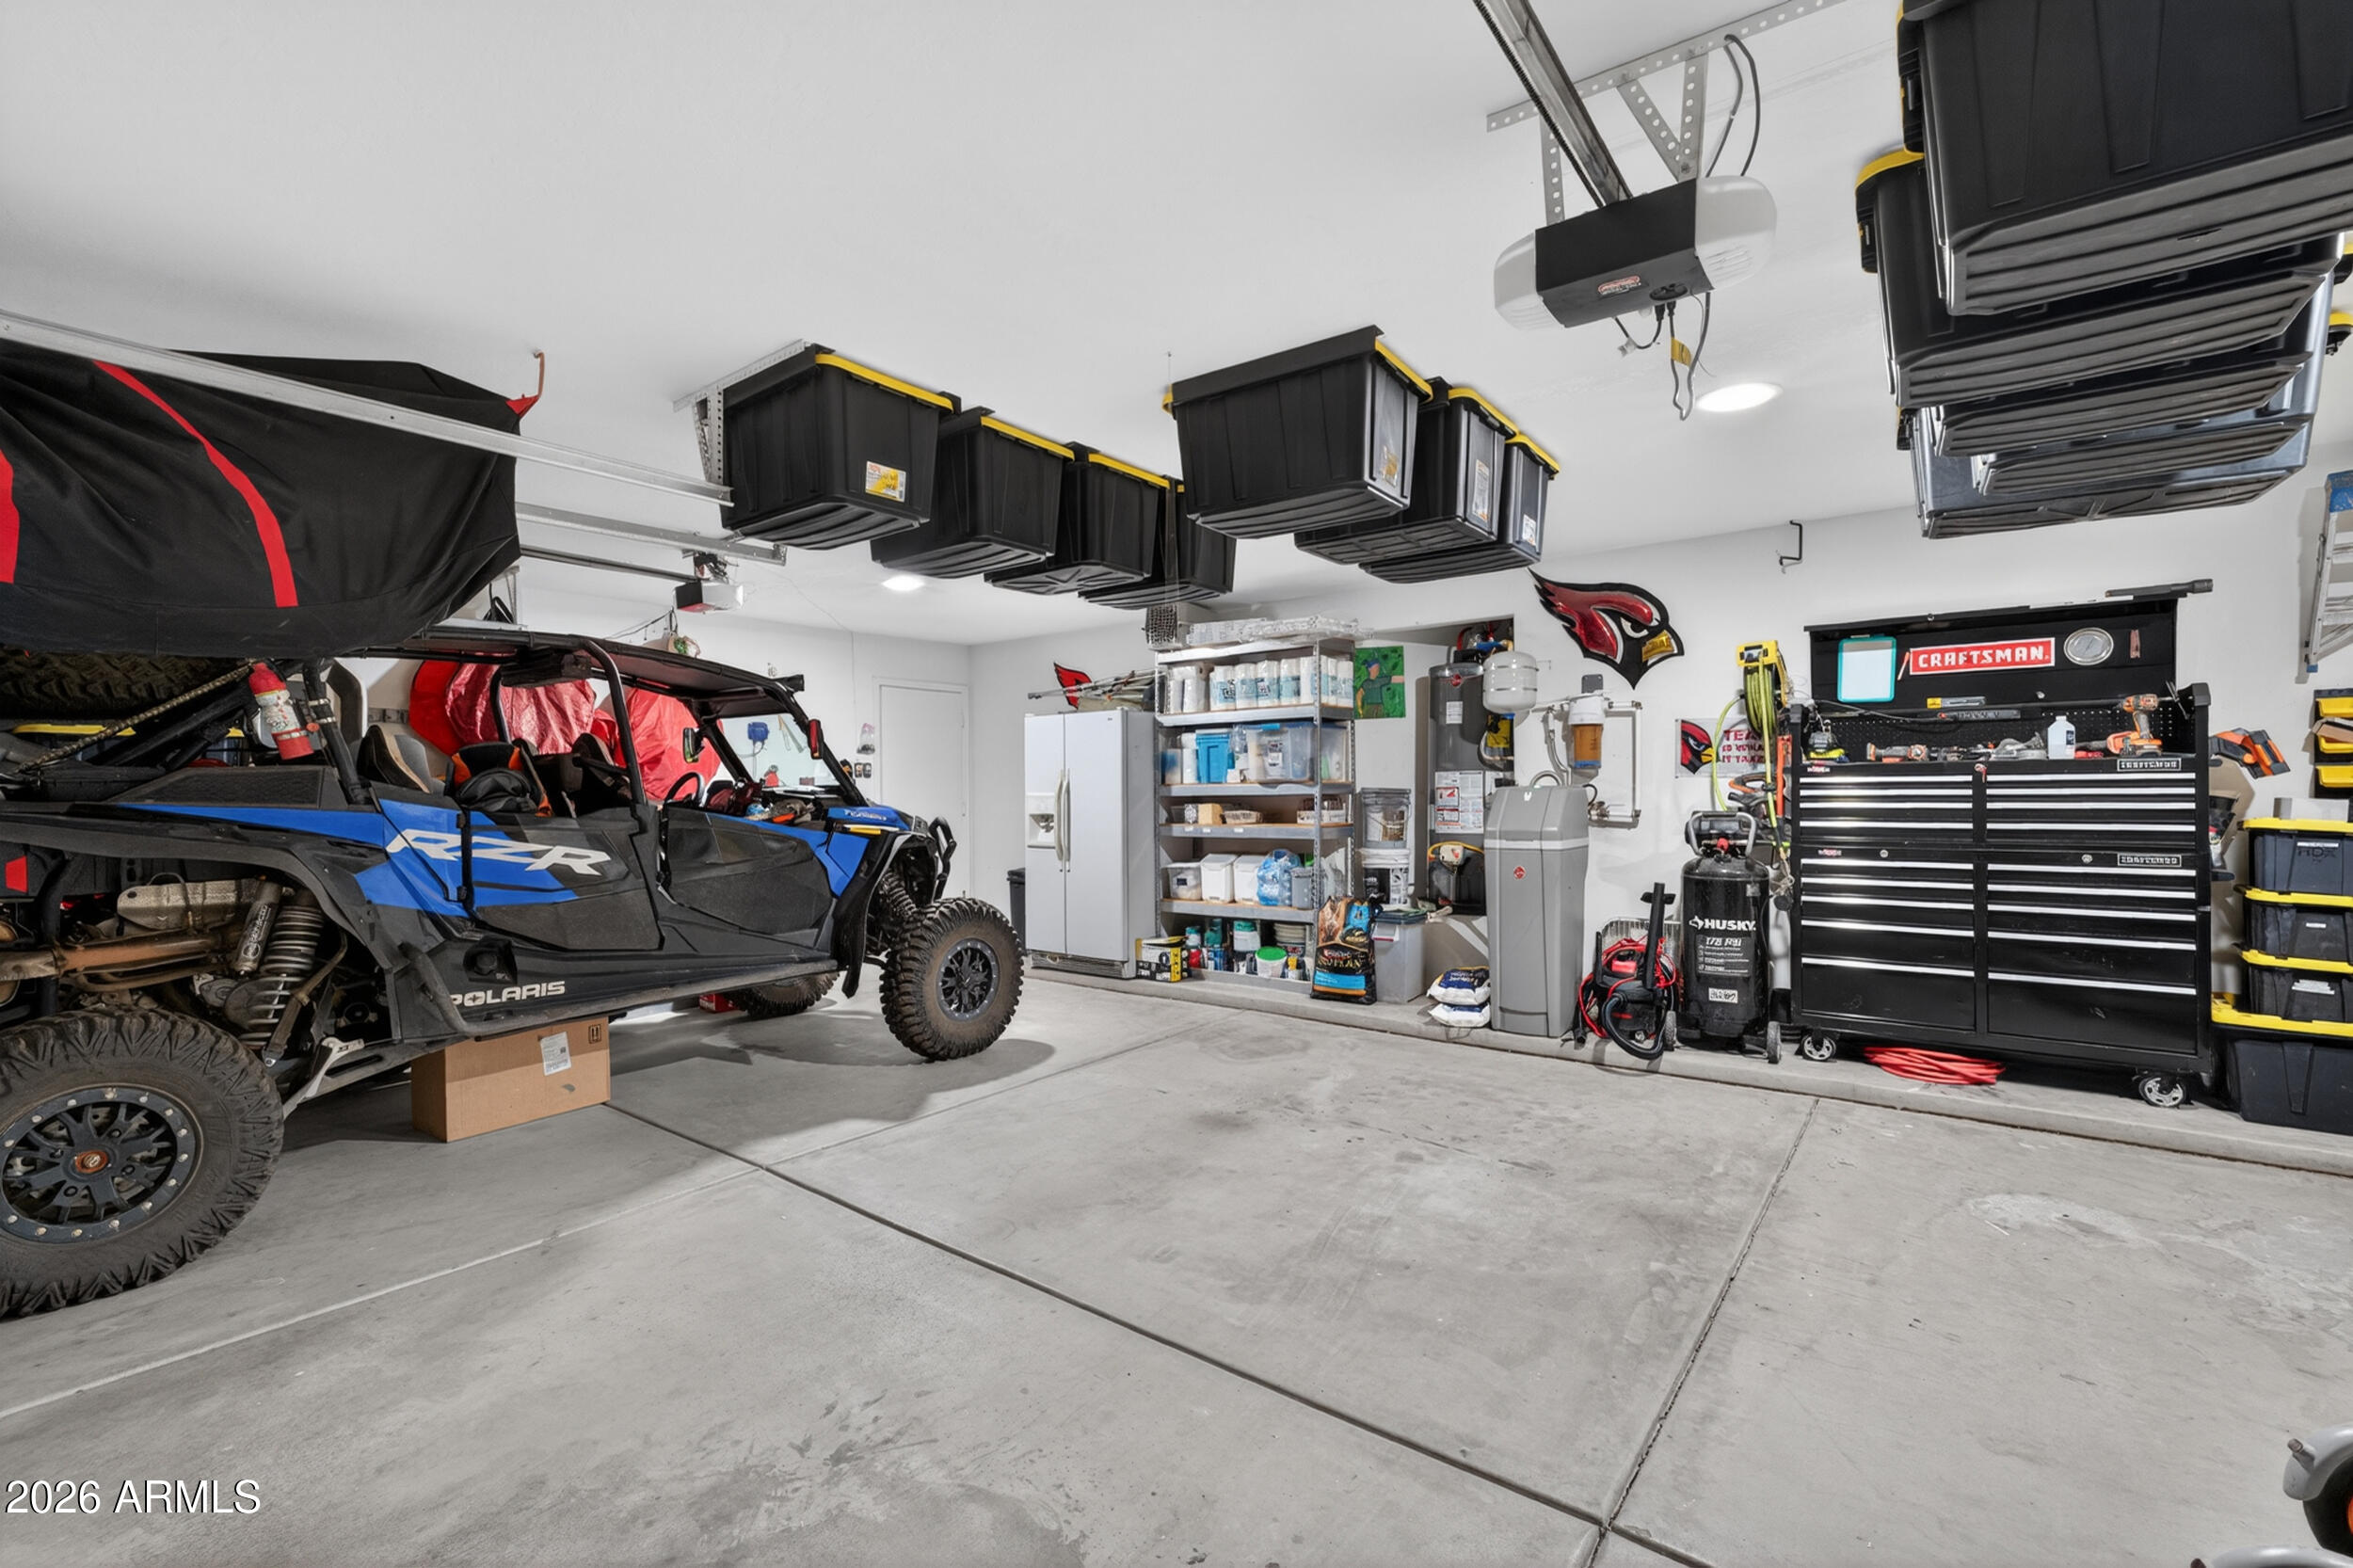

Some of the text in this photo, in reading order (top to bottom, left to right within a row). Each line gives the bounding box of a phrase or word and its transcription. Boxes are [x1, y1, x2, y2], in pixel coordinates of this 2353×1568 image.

[1917, 645, 2045, 668] CRAFTSMAN
[385, 828, 612, 876] RZR
[450, 981, 566, 1007] POLARIS
